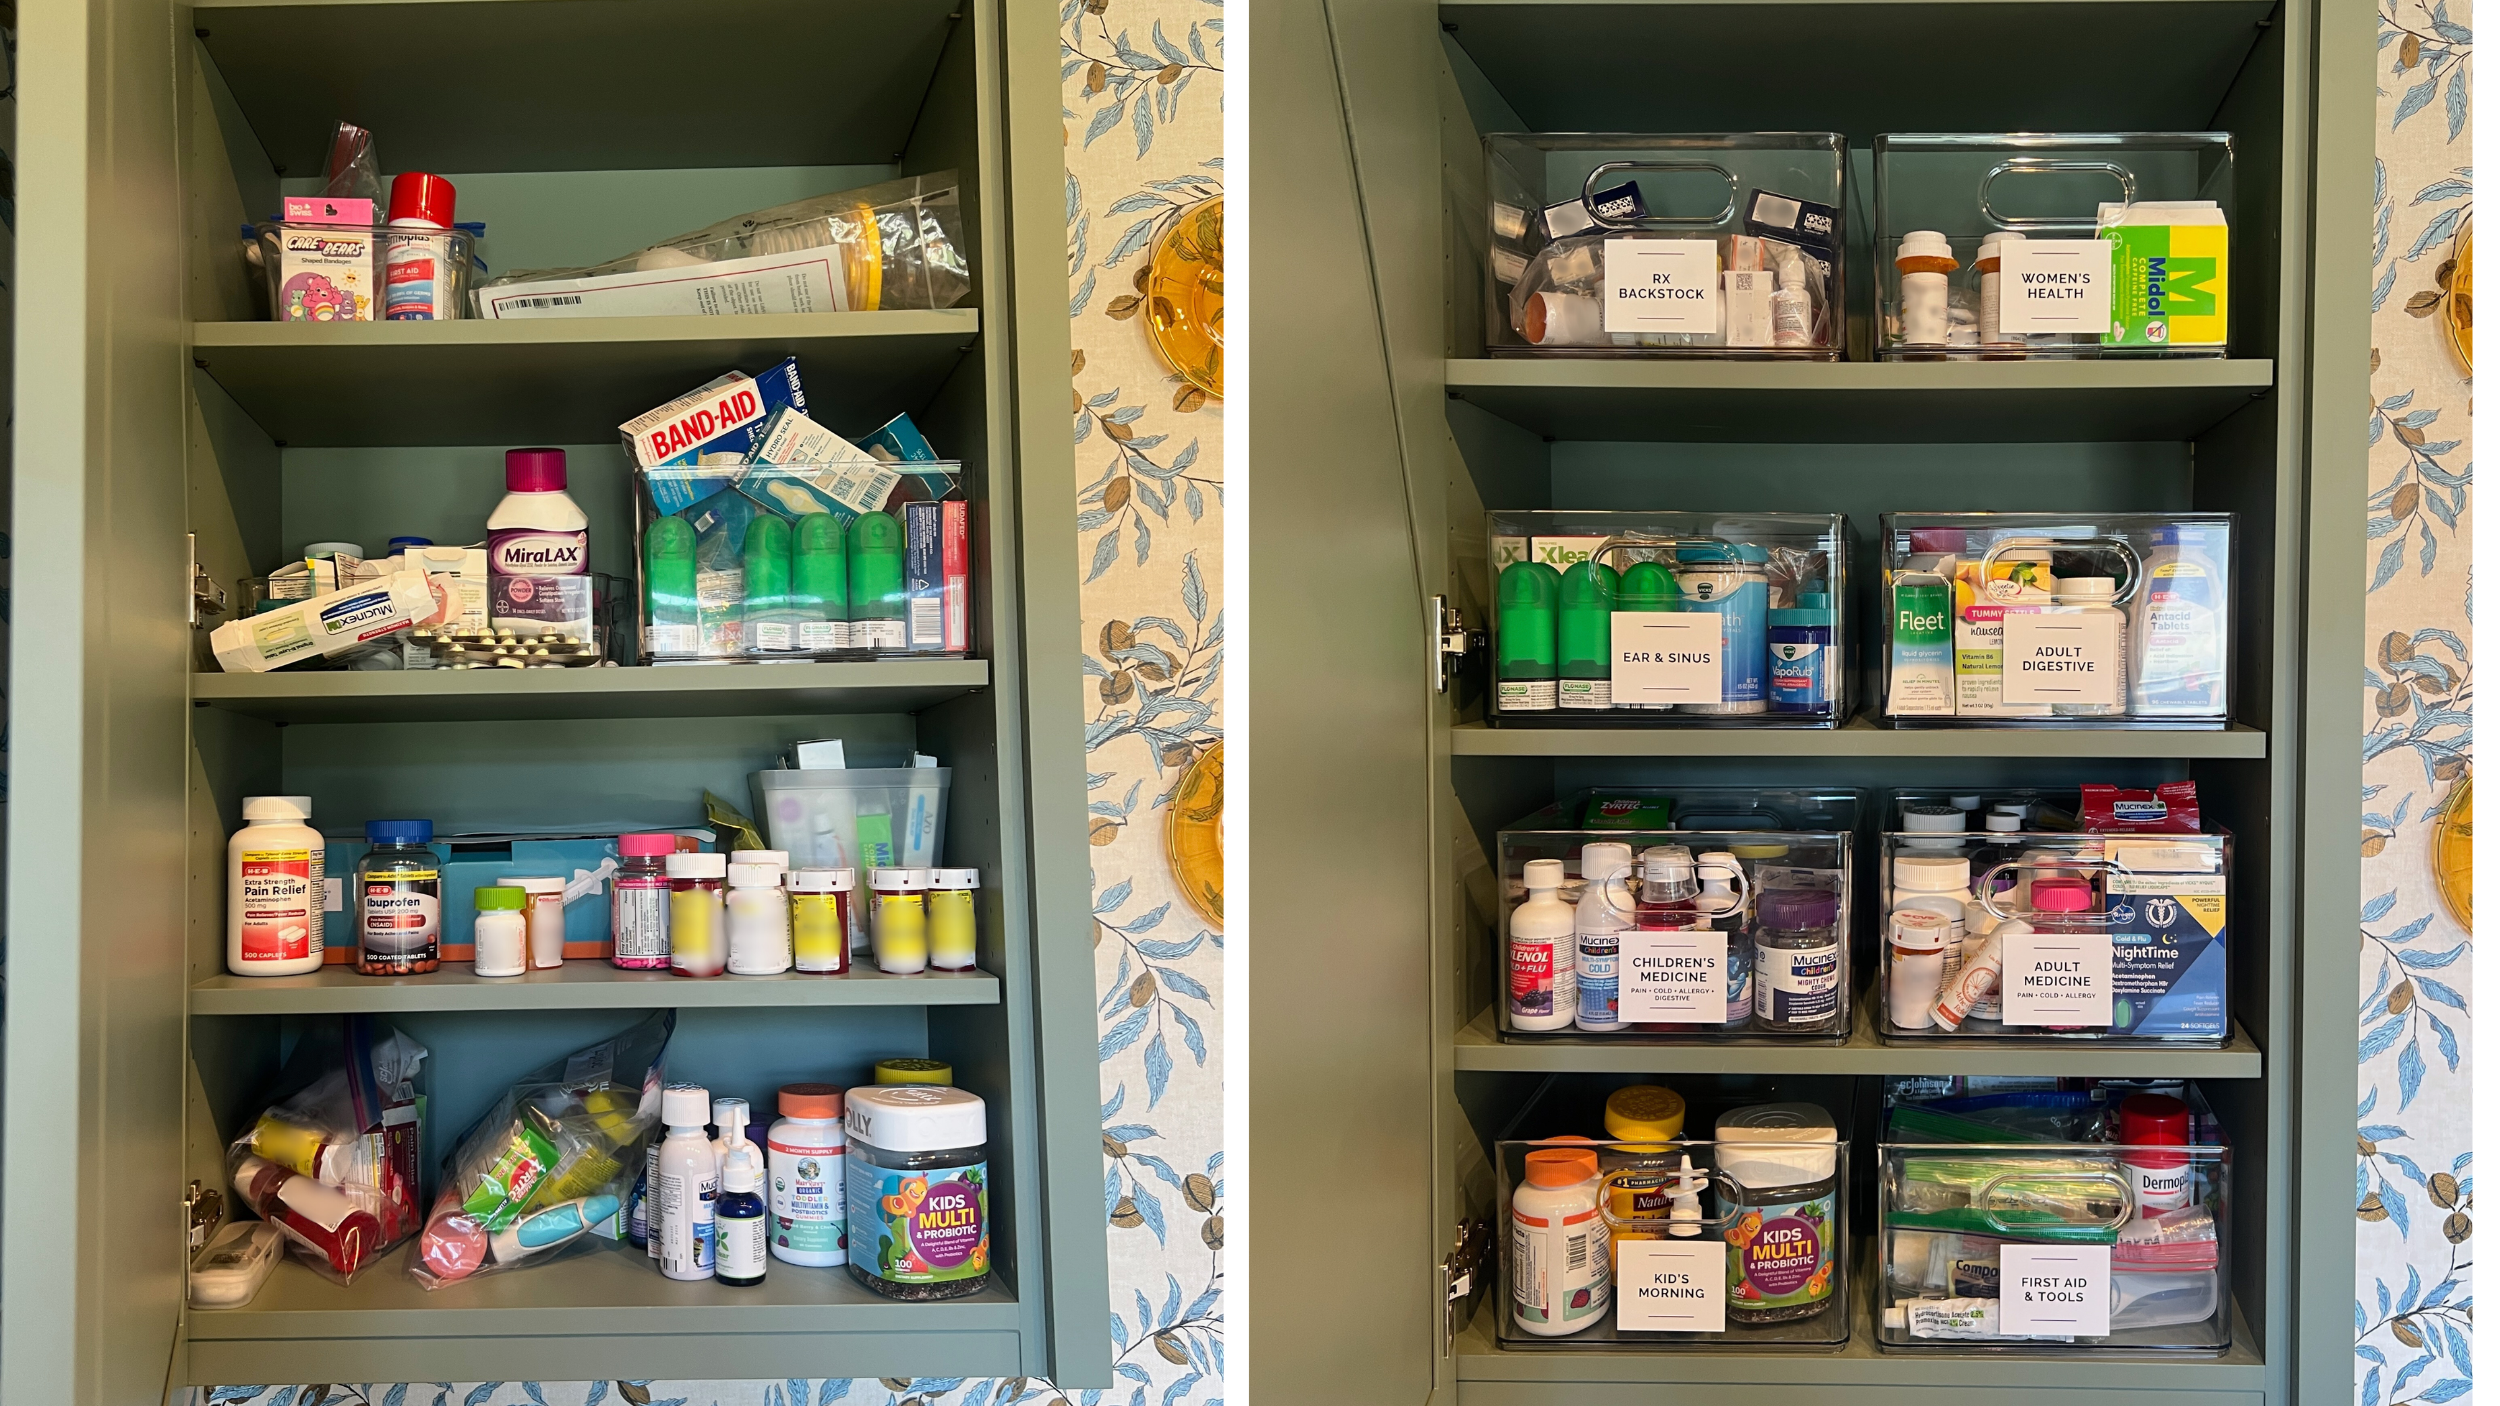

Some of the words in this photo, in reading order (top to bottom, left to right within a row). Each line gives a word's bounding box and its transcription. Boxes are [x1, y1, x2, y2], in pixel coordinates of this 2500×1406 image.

[287, 236, 322, 250] CARE
[322, 242, 364, 256] BEARS
[1653, 274, 1671, 284] RX
[2022, 273, 2091, 285] WOMEN'S
[2148, 258, 2166, 316] Midol
[1619, 288, 1704, 299] BACKSTOCK
[2027, 288, 2084, 300] HEALTH
[786, 362, 806, 407] BAND-AID
[650, 390, 757, 460] BAND-AID
[766, 434, 783, 458] HYDRO
[781, 418, 794, 436] SEAL
[504, 546, 578, 564] MiraLAX
[340, 602, 393, 626] Mucinex
[2150, 612, 2190, 621] Antacid
[1900, 610, 1944, 630] Fleet
[2151, 622, 2189, 630] Tablets
[1902, 650, 1917, 658] liquid
[1919, 650, 1942, 658] glycerin
[2035, 647, 2082, 657] ADULT
[1623, 653, 1650, 663] EAR
[1654, 653, 1664, 663] &
[1668, 653, 1710, 664] SINUS
[1772, 666, 1812, 678] VapoRub
[2022, 661, 2095, 672] DIGESTIVE
[1600, 802, 1640, 810] ZYRTEC
[264, 878, 295, 886] Strength
[244, 886, 268, 895] Pain
[272, 884, 306, 895] Relief
[367, 898, 420, 908] Ibuprofen
[2113, 910, 2134, 919] Kroger
[1513, 944, 1540, 952] Children's
[1633, 957, 1715, 968] CHILDREN'S
[1794, 952, 1837, 966] Mucinex
[1589, 964, 1611, 973] COLD
[1800, 964, 1834, 975] Children's
[2034, 962, 2081, 972] ADULT
[2158, 962, 2174, 970] Relief
[1640, 972, 1707, 983] MEDICINE
[1798, 978, 1819, 986] MIGHTY
[2024, 976, 2091, 986] MEDICINE
[929, 1195, 965, 1211] KIDS
[919, 1208, 974, 1229] MULTI
[924, 1225, 977, 1239] PROBIOTIC
[1764, 1228, 1802, 1244] KIDS
[1753, 1240, 1812, 1260] MULTI
[895, 1259, 912, 1267] 100
[1757, 1256, 1814, 1270] PROBIOTIC
[1654, 1274, 1689, 1284] KID'S
[2022, 1277, 2059, 1287] FIRST
[2064, 1278, 2087, 1288] AID
[1639, 1288, 1705, 1299] MORNING
[1731, 1286, 1746, 1295] 100
[2025, 1293, 2032, 1301] &
[2038, 1292, 2084, 1302] TOOLS
[1915, 1311, 1950, 1319] Hydrocortisone
